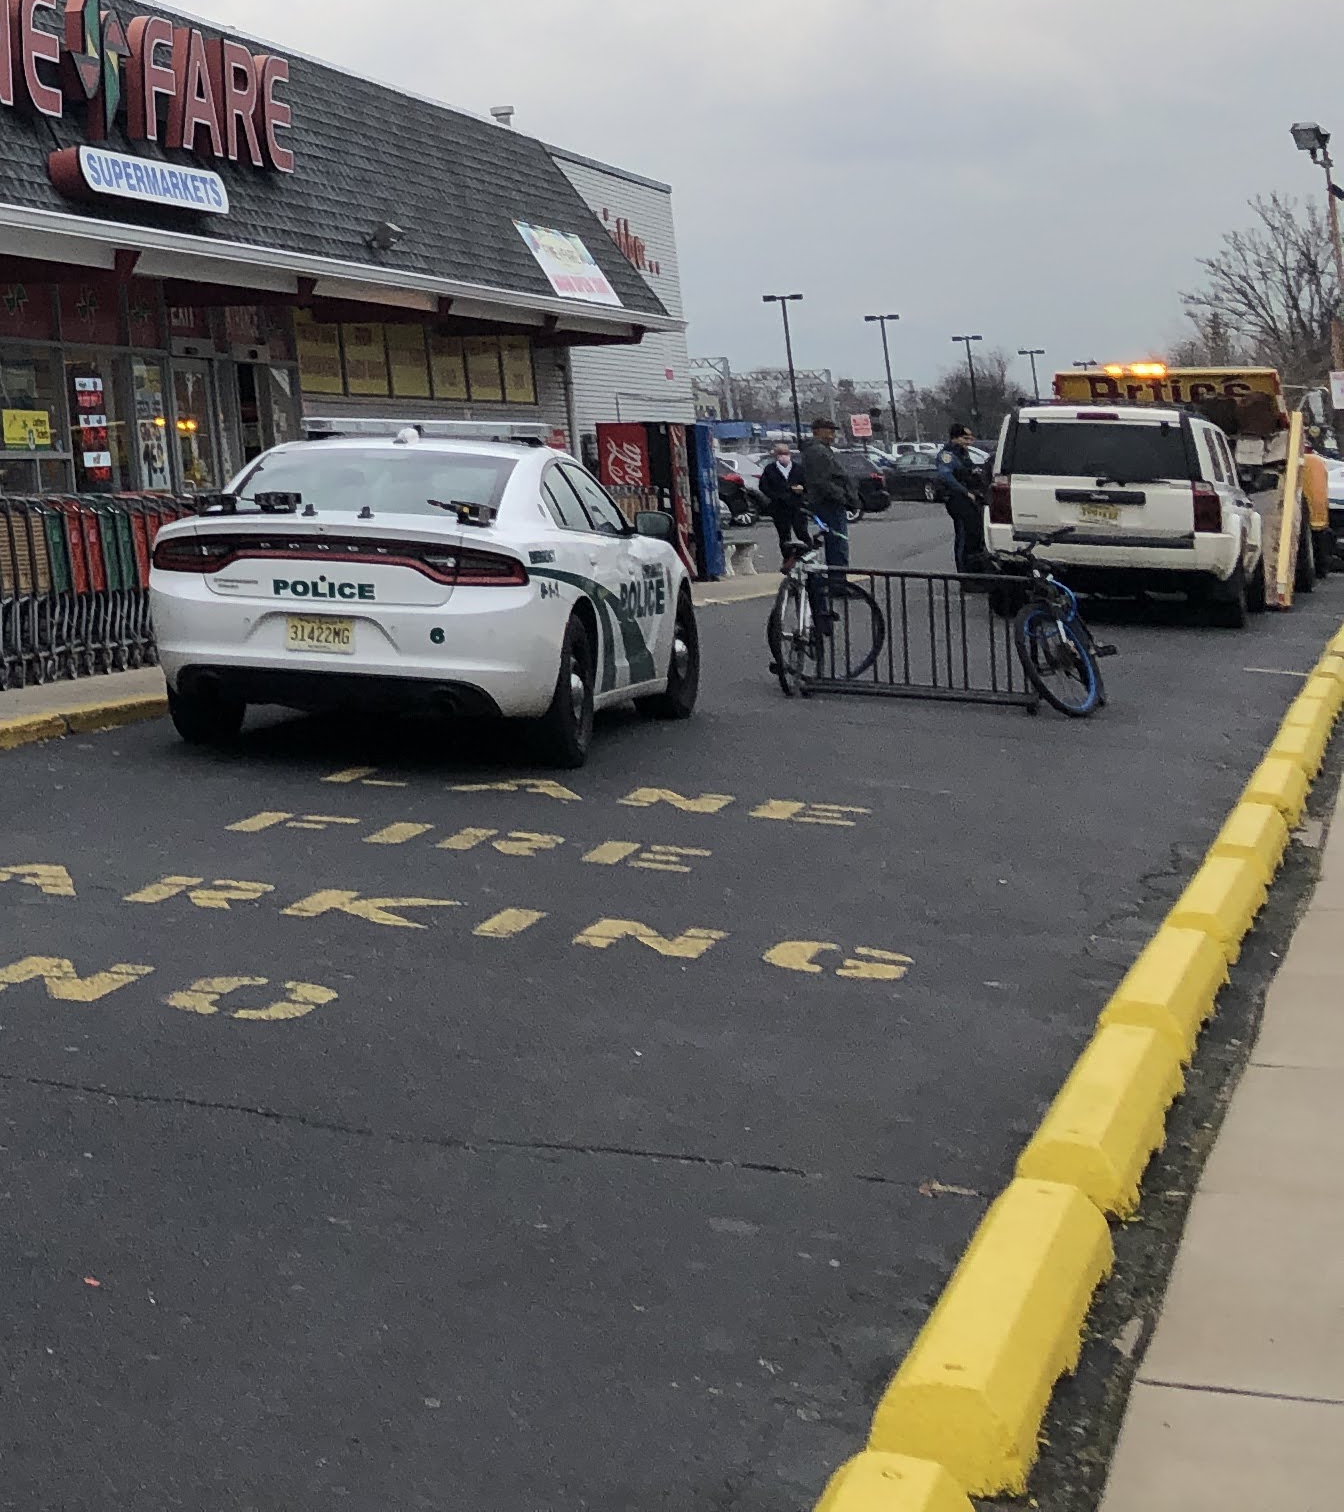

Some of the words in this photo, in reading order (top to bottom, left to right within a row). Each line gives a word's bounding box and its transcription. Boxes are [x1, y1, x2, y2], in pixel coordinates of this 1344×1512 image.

[127, 15, 295, 173] FARE
[86, 152, 223, 208] SUPERMARKETS
[273, 579, 376, 601] POLICE
[319, 767, 871, 826] LANE
[224, 809, 712, 873] FIRE
